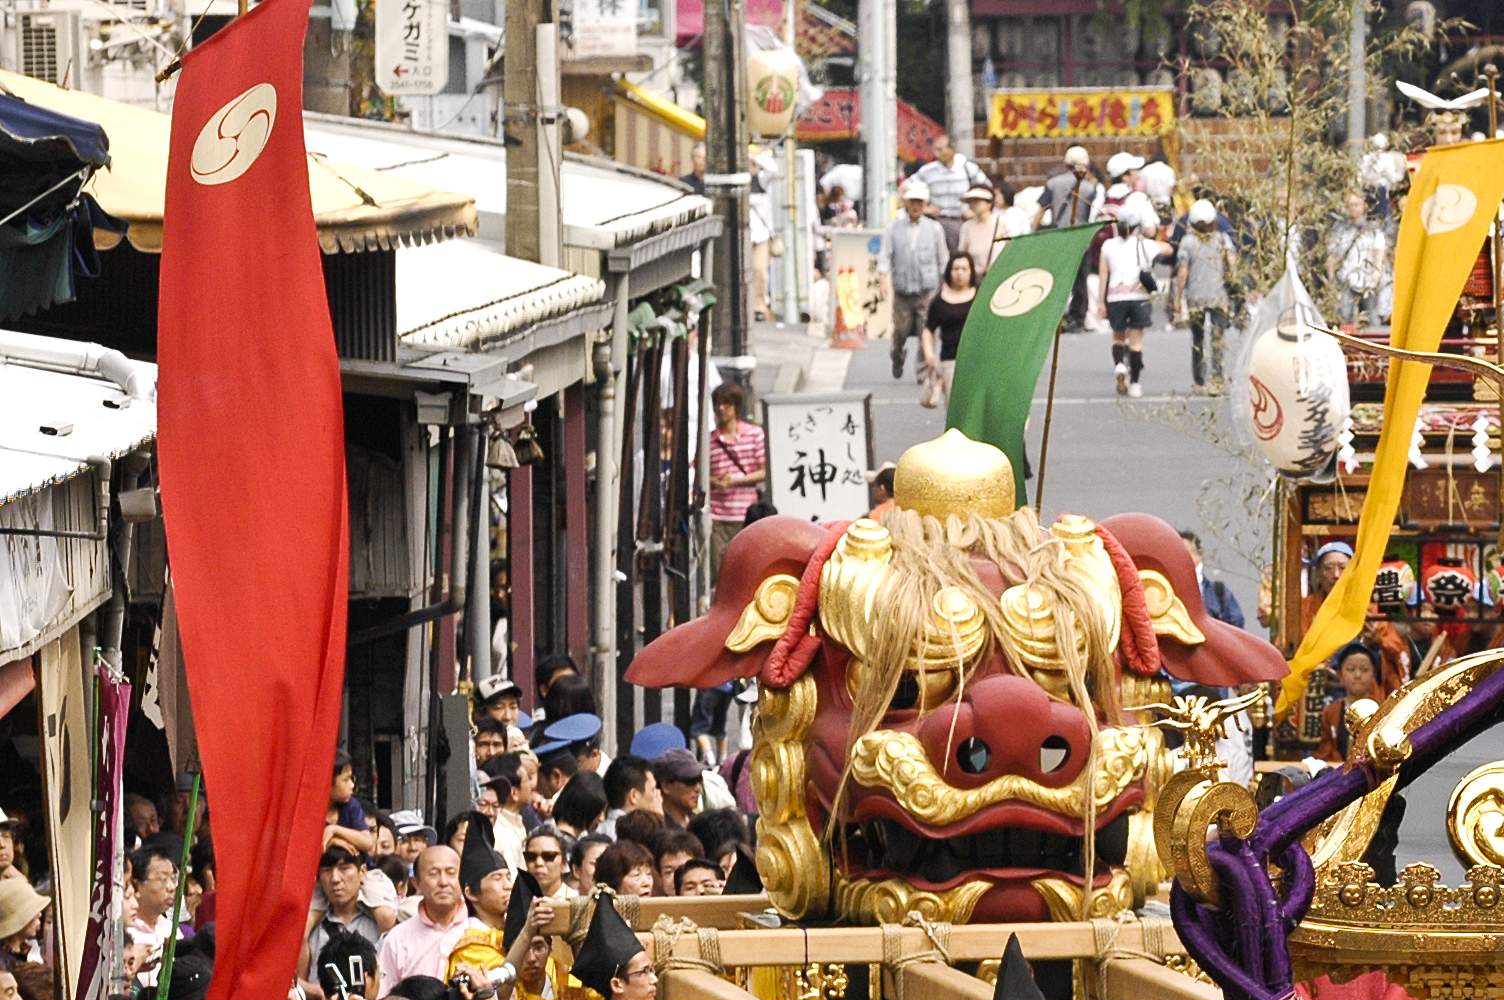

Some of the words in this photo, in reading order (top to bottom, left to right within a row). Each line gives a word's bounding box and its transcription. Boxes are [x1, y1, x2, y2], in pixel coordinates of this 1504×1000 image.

[402, 0, 422, 62] ケガミ
[1429, 574, 1471, 606] 祭
